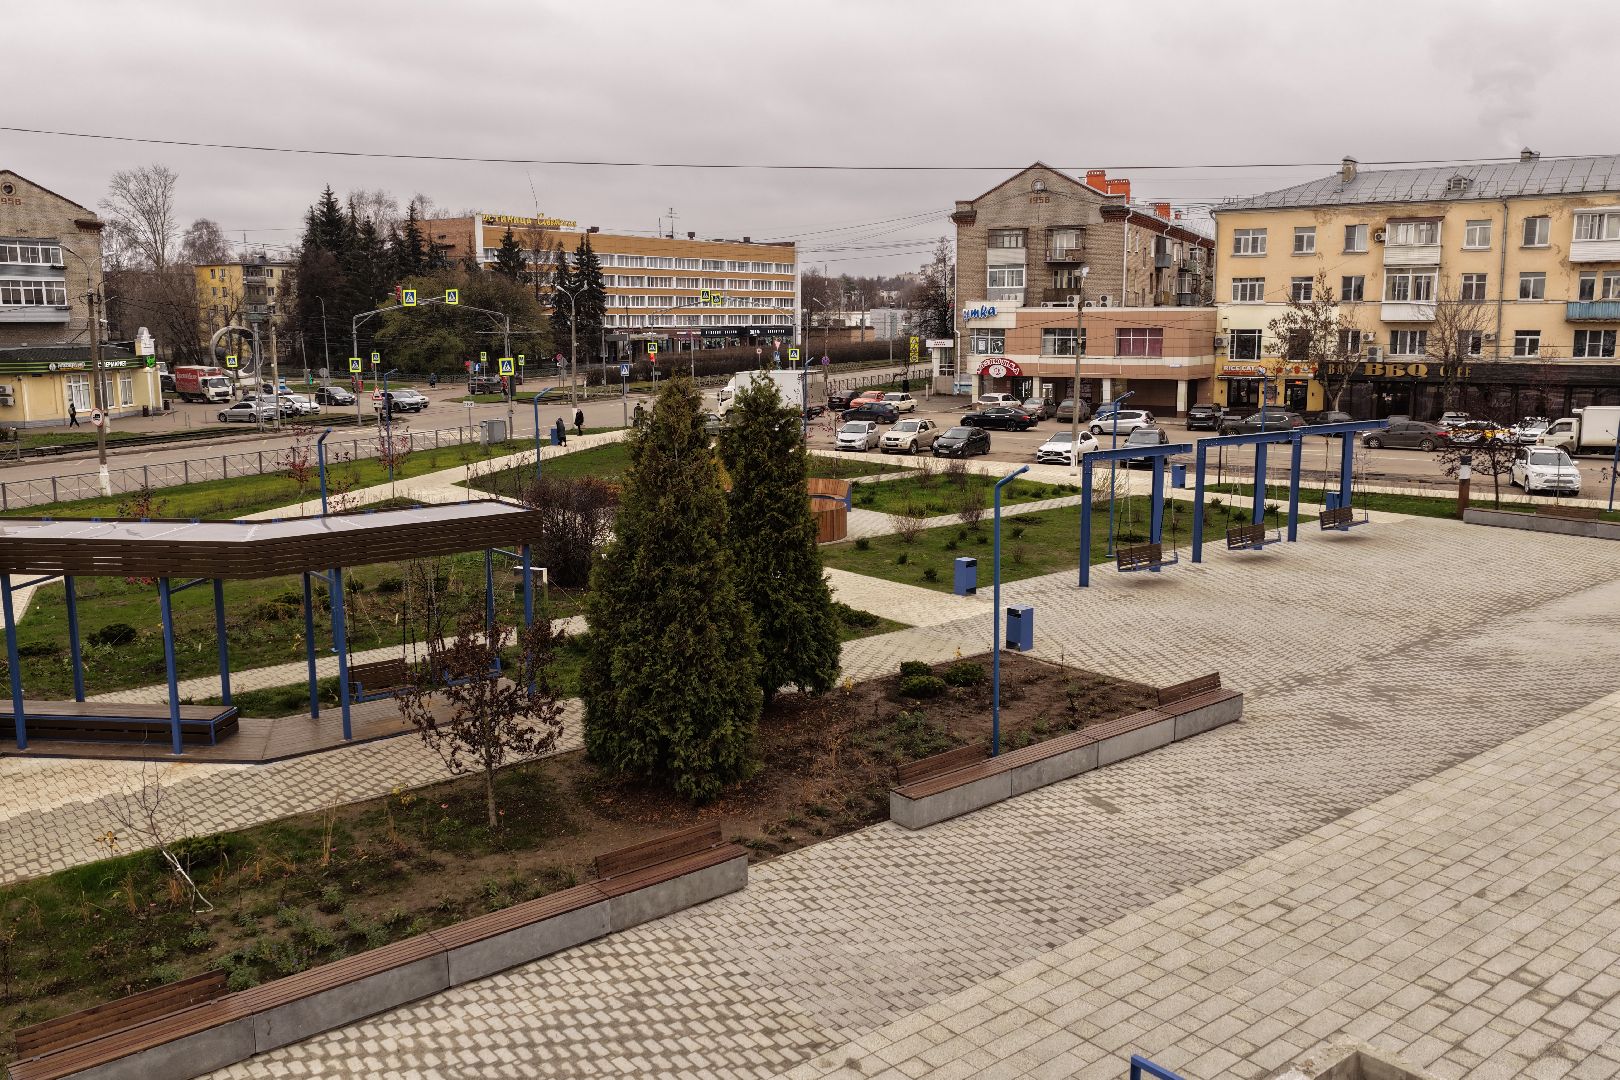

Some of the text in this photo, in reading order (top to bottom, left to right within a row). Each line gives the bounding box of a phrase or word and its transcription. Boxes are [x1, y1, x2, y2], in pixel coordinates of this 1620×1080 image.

[1029, 196, 1050, 204] 1958
[1363, 363, 1428, 378] BBQ
[1439, 365, 1472, 378] CFE
